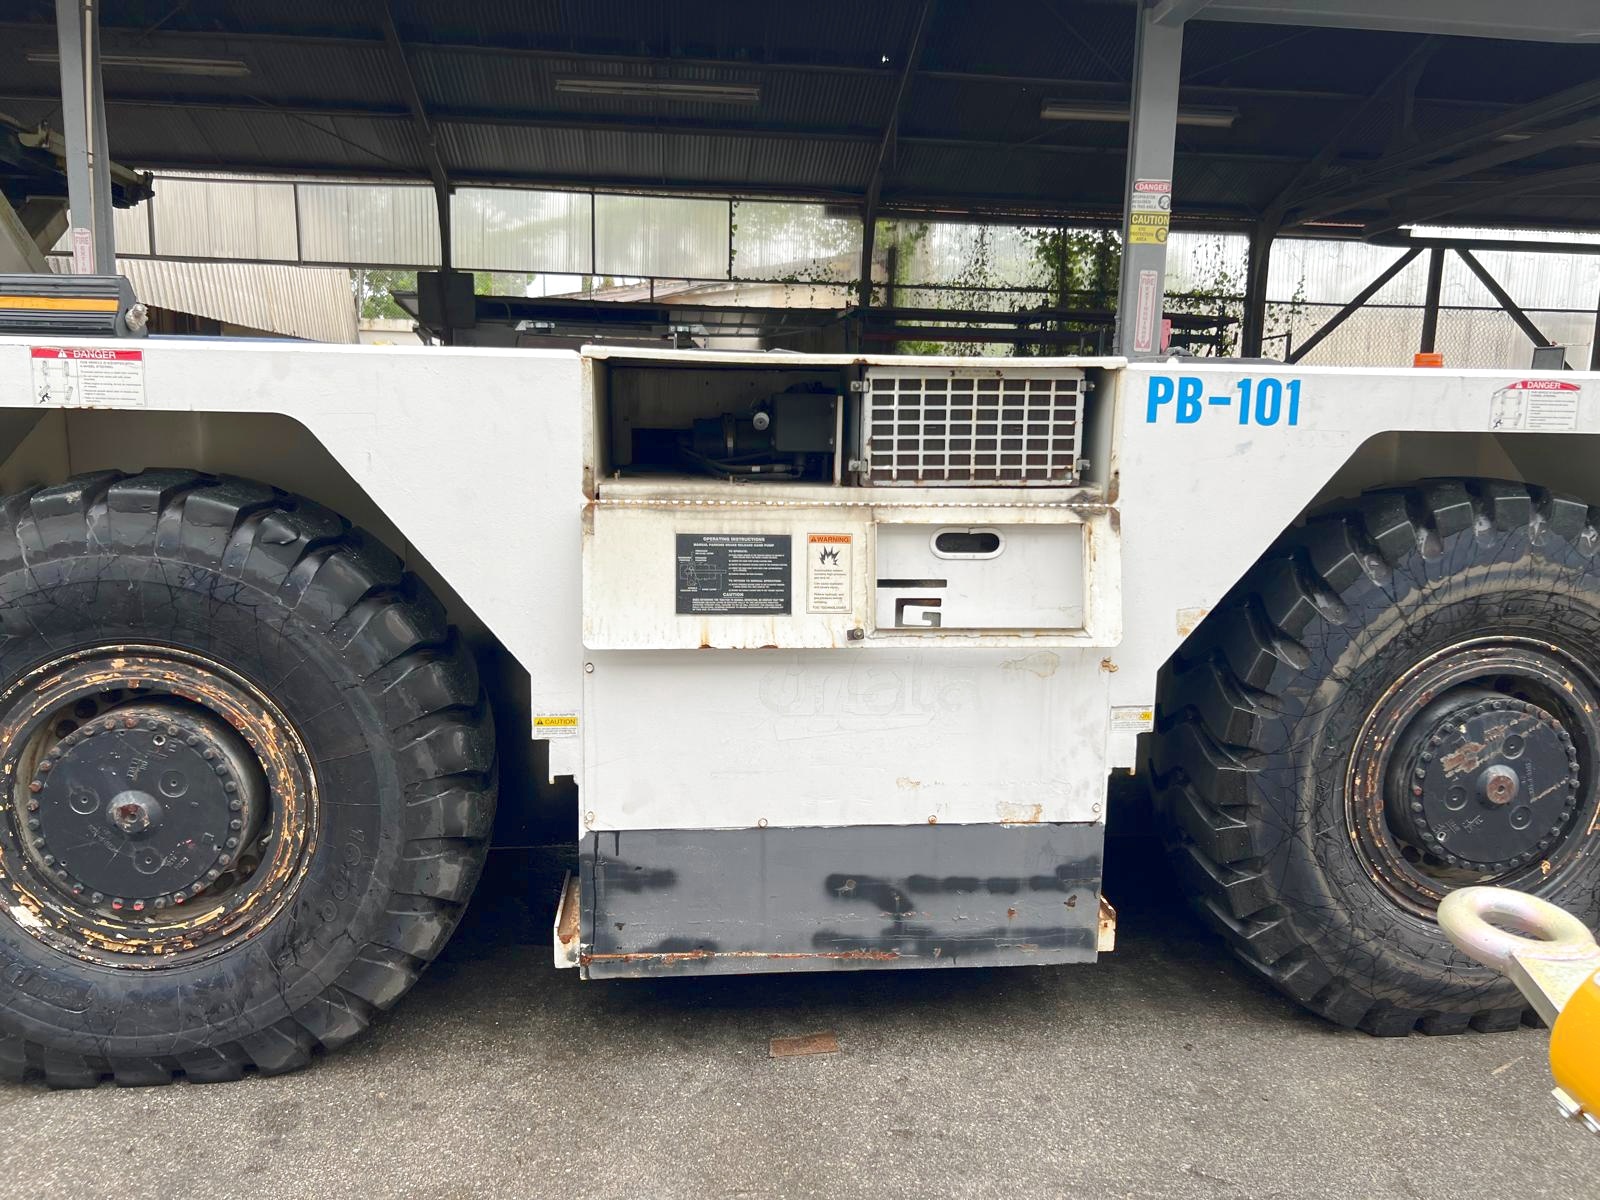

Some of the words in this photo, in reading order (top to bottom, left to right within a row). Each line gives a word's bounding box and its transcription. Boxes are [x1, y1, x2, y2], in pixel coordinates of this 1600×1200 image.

[1139, 183, 1168, 191] DANGER
[1132, 215, 1169, 225] CAUTION
[73, 350, 117, 359] DANGER
[1527, 381, 1561, 389] DANGER
[1146, 376, 1301, 426] PB-101
